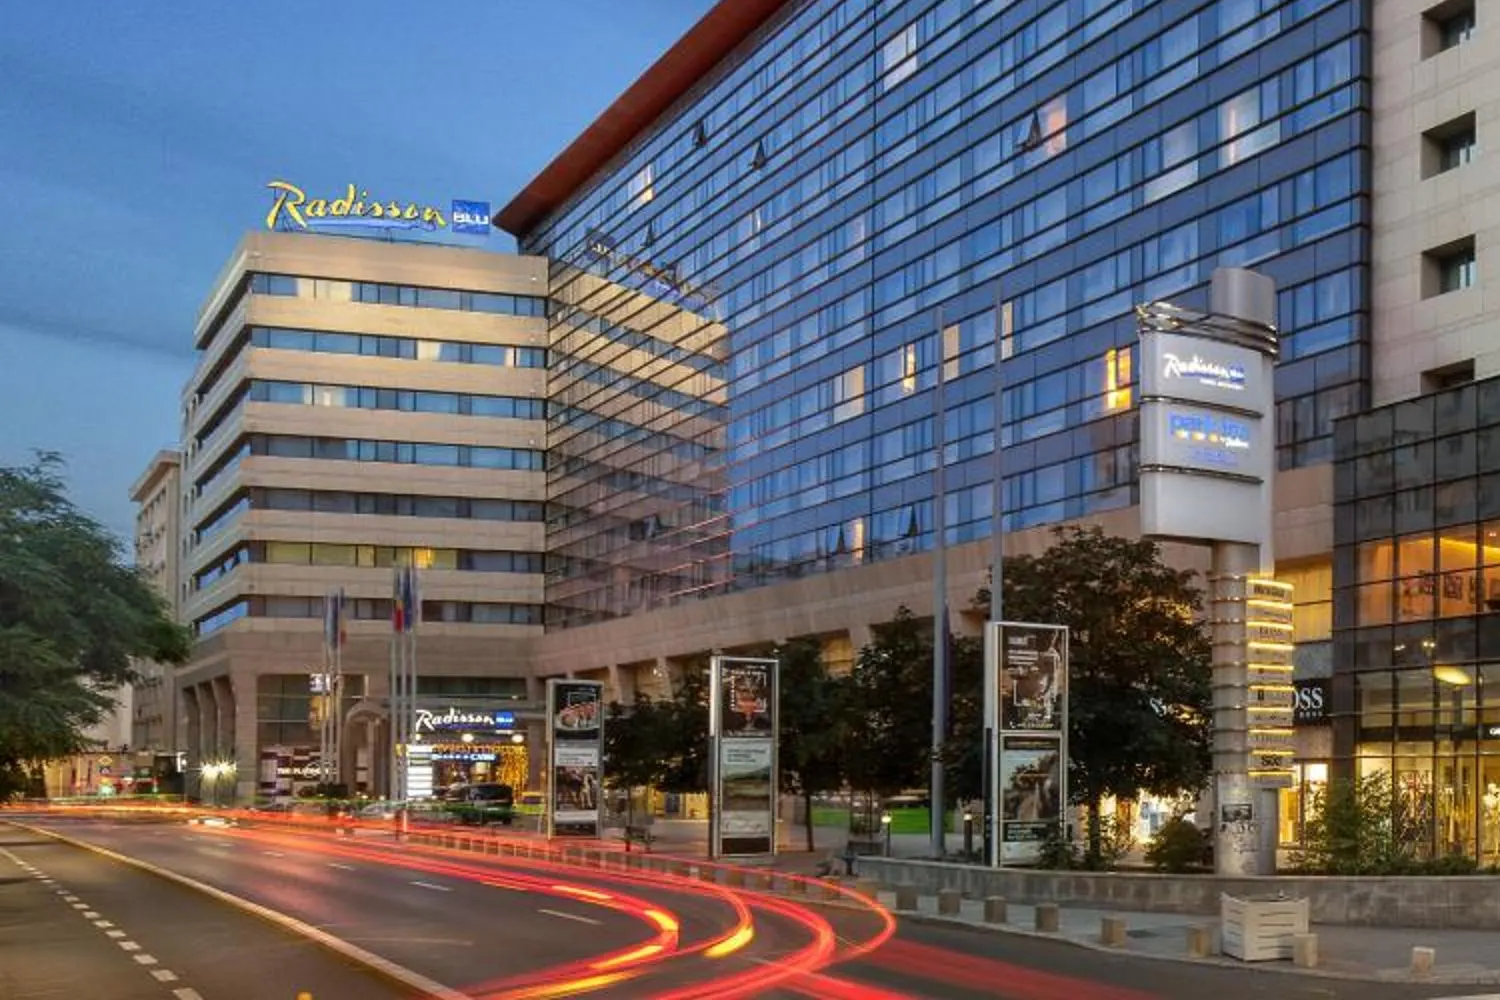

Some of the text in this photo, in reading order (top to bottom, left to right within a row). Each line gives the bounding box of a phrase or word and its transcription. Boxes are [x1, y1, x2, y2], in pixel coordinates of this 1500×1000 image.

[266, 180, 489, 230] Radisson BLU
[1293, 687, 1323, 710] SS
[415, 707, 495, 732] Radisson
